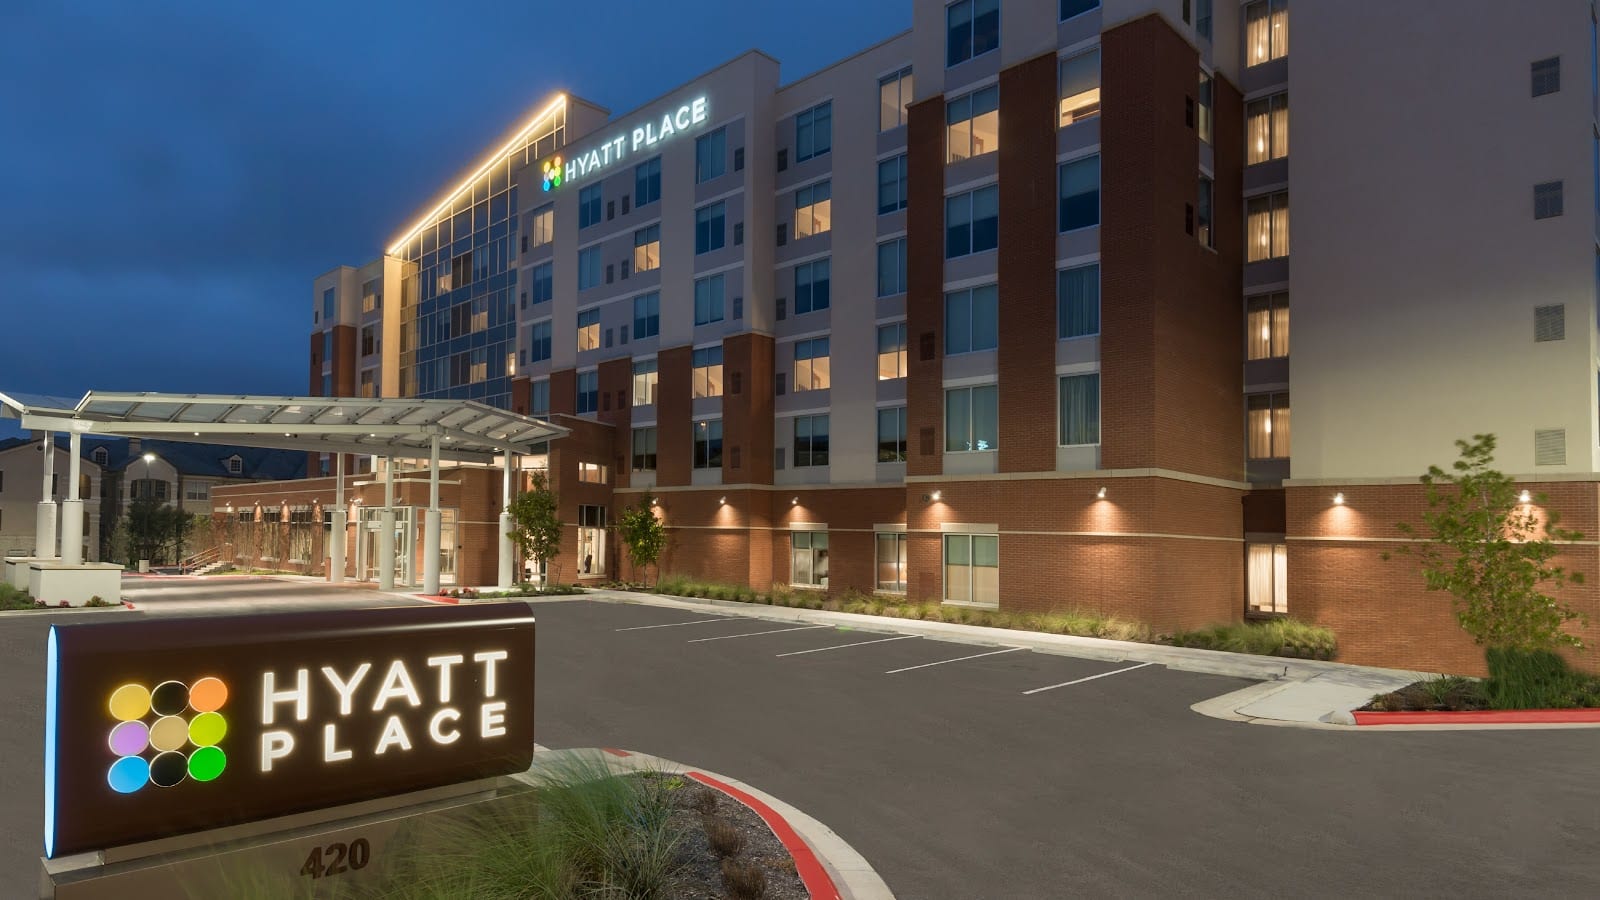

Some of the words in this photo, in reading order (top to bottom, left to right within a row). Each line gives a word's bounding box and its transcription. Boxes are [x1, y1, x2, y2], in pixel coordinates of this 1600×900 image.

[565, 135, 625, 182] HYATT
[632, 97, 706, 151] PLACE
[261, 650, 508, 724] HYATT
[261, 702, 507, 772] PLACE
[300, 837, 371, 880] 420
